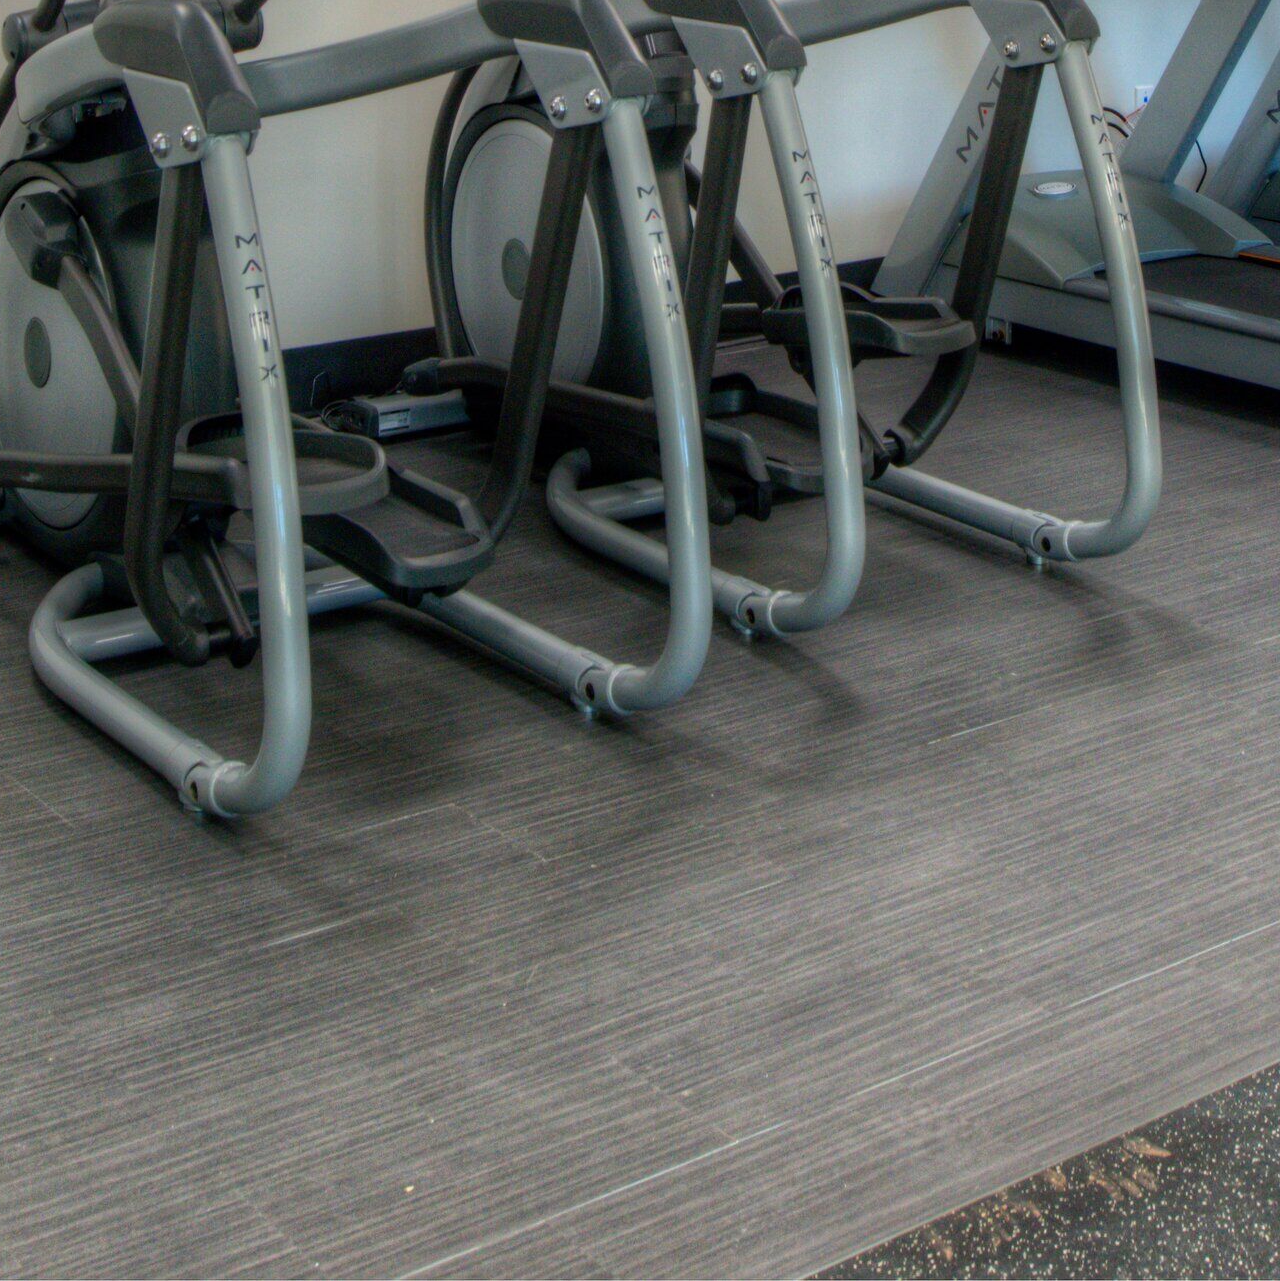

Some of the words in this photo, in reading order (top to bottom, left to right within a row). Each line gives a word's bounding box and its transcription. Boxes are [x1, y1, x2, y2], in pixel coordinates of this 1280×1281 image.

[956, 65, 1001, 164] MAT
[637, 185, 680, 318] MATRIX
[791, 149, 832, 271] MATRIX
[235, 232, 278, 382] MATRIX
